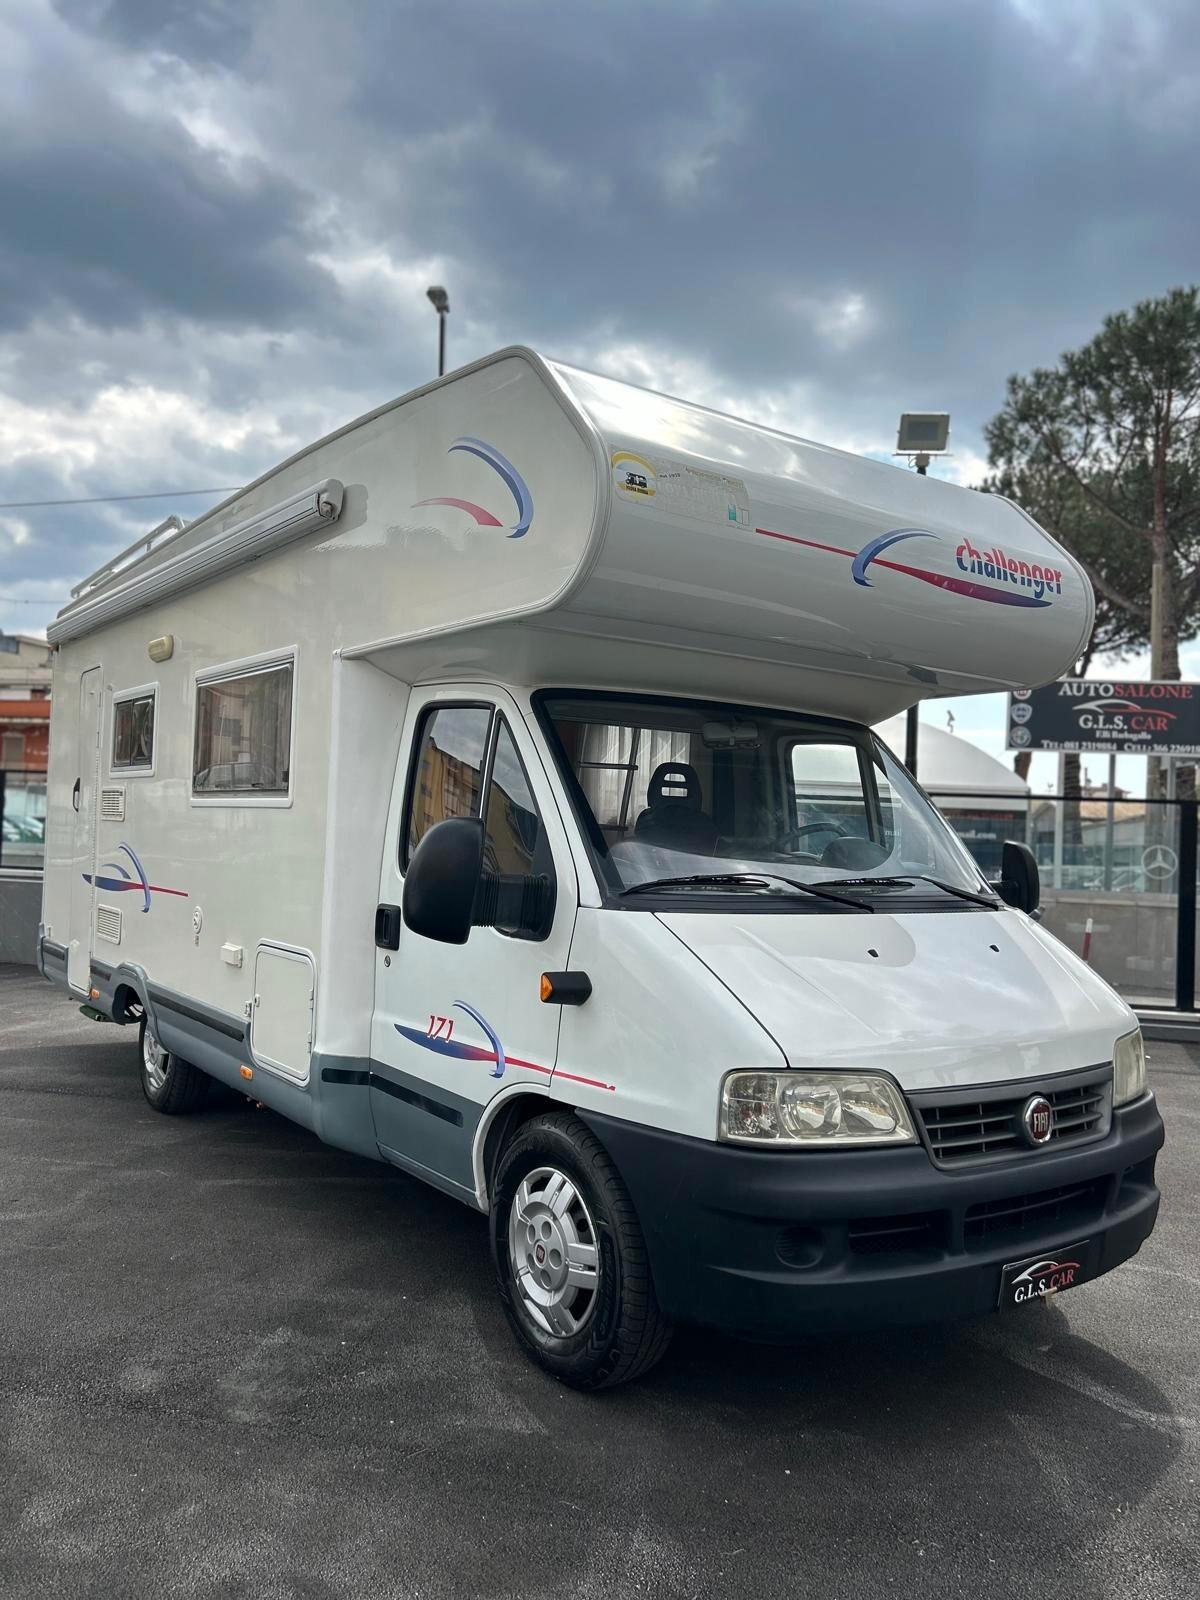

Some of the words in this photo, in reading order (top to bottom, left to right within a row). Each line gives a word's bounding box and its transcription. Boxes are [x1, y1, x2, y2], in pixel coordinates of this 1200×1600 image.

[1058, 683, 1192, 698] AUTOSALONE
[1078, 714, 1128, 730] G.L.S.
[1130, 716, 1168, 731] CAR
[428, 1016, 454, 1041] 171
[1033, 1112, 1048, 1132] FIAT
[1049, 1269, 1075, 1290] CAR
